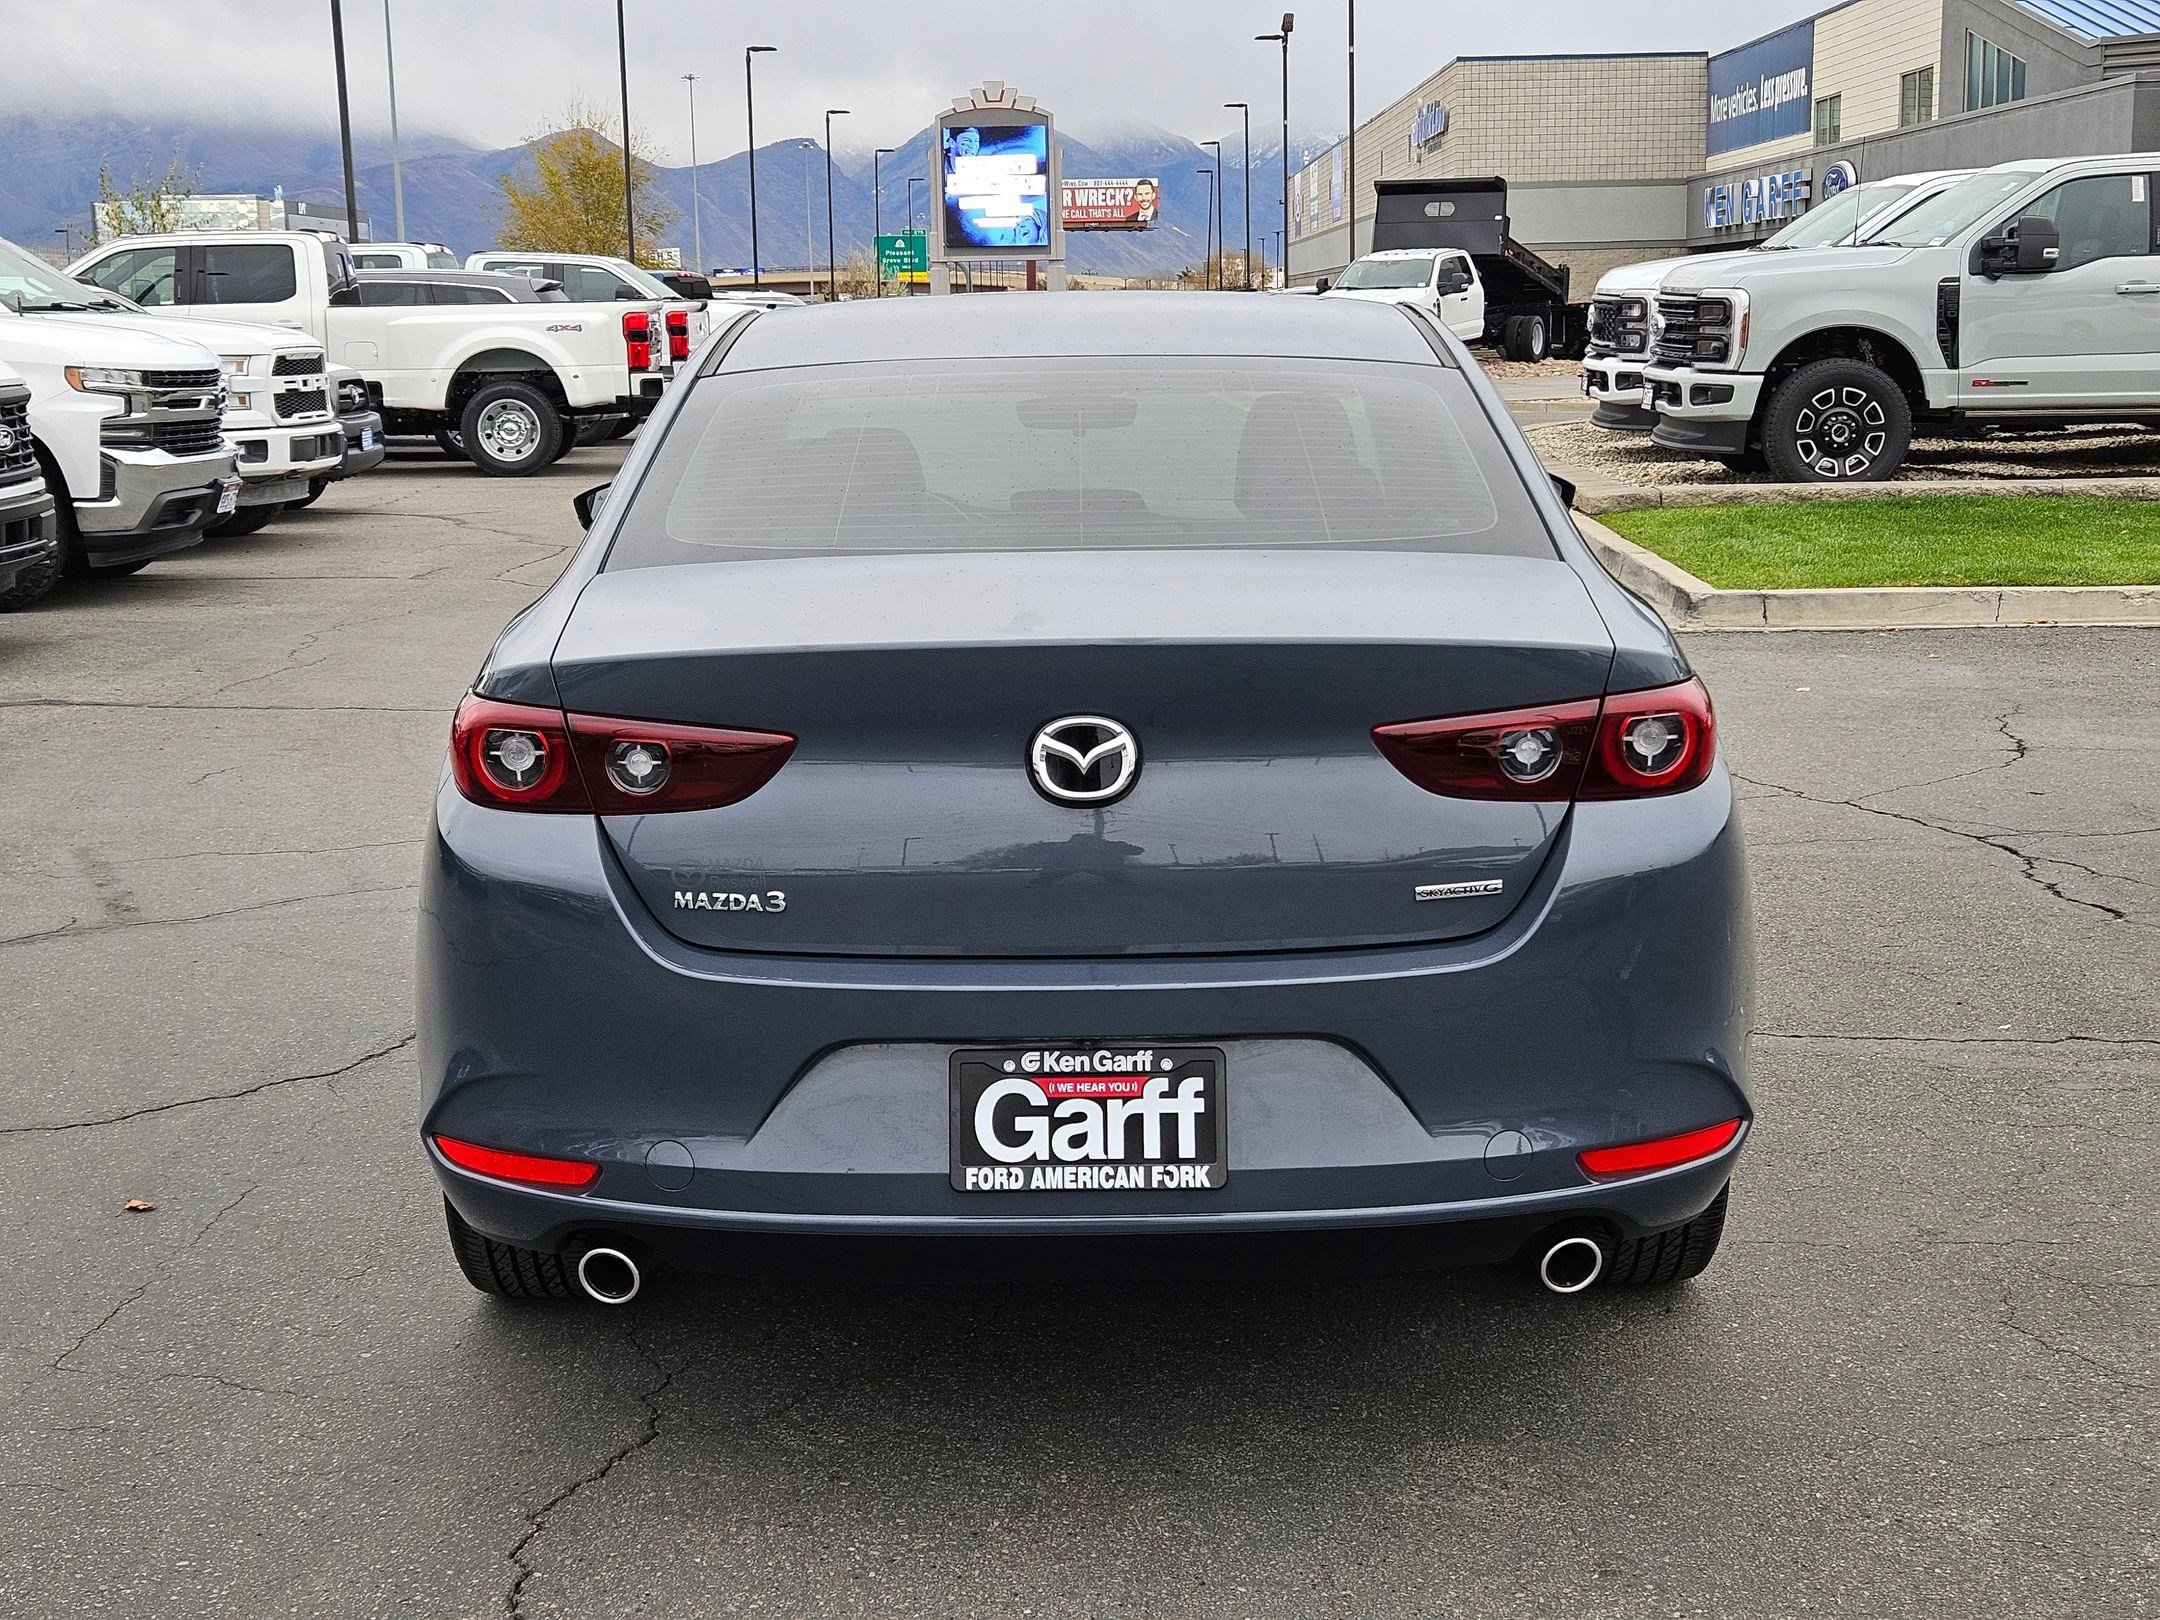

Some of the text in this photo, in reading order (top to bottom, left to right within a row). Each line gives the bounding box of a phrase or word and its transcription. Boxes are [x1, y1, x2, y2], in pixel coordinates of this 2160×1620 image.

[1710, 66, 1808, 124] More vehicles. Less pressure.
[1075, 188, 1134, 207] WRECK?
[1704, 168, 1812, 229] KEN GARFF
[1071, 208, 1088, 219] CALL
[1089, 208, 1111, 218] THAT'S
[1112, 207, 1126, 218] ALL
[1043, 1049, 1153, 1073] Ken Garff
[1056, 1082, 1131, 1093] WE HEAR YOU
[974, 1076, 1205, 1164] Garff
[965, 1165, 1212, 1190] FORD AMERICAN FORK
